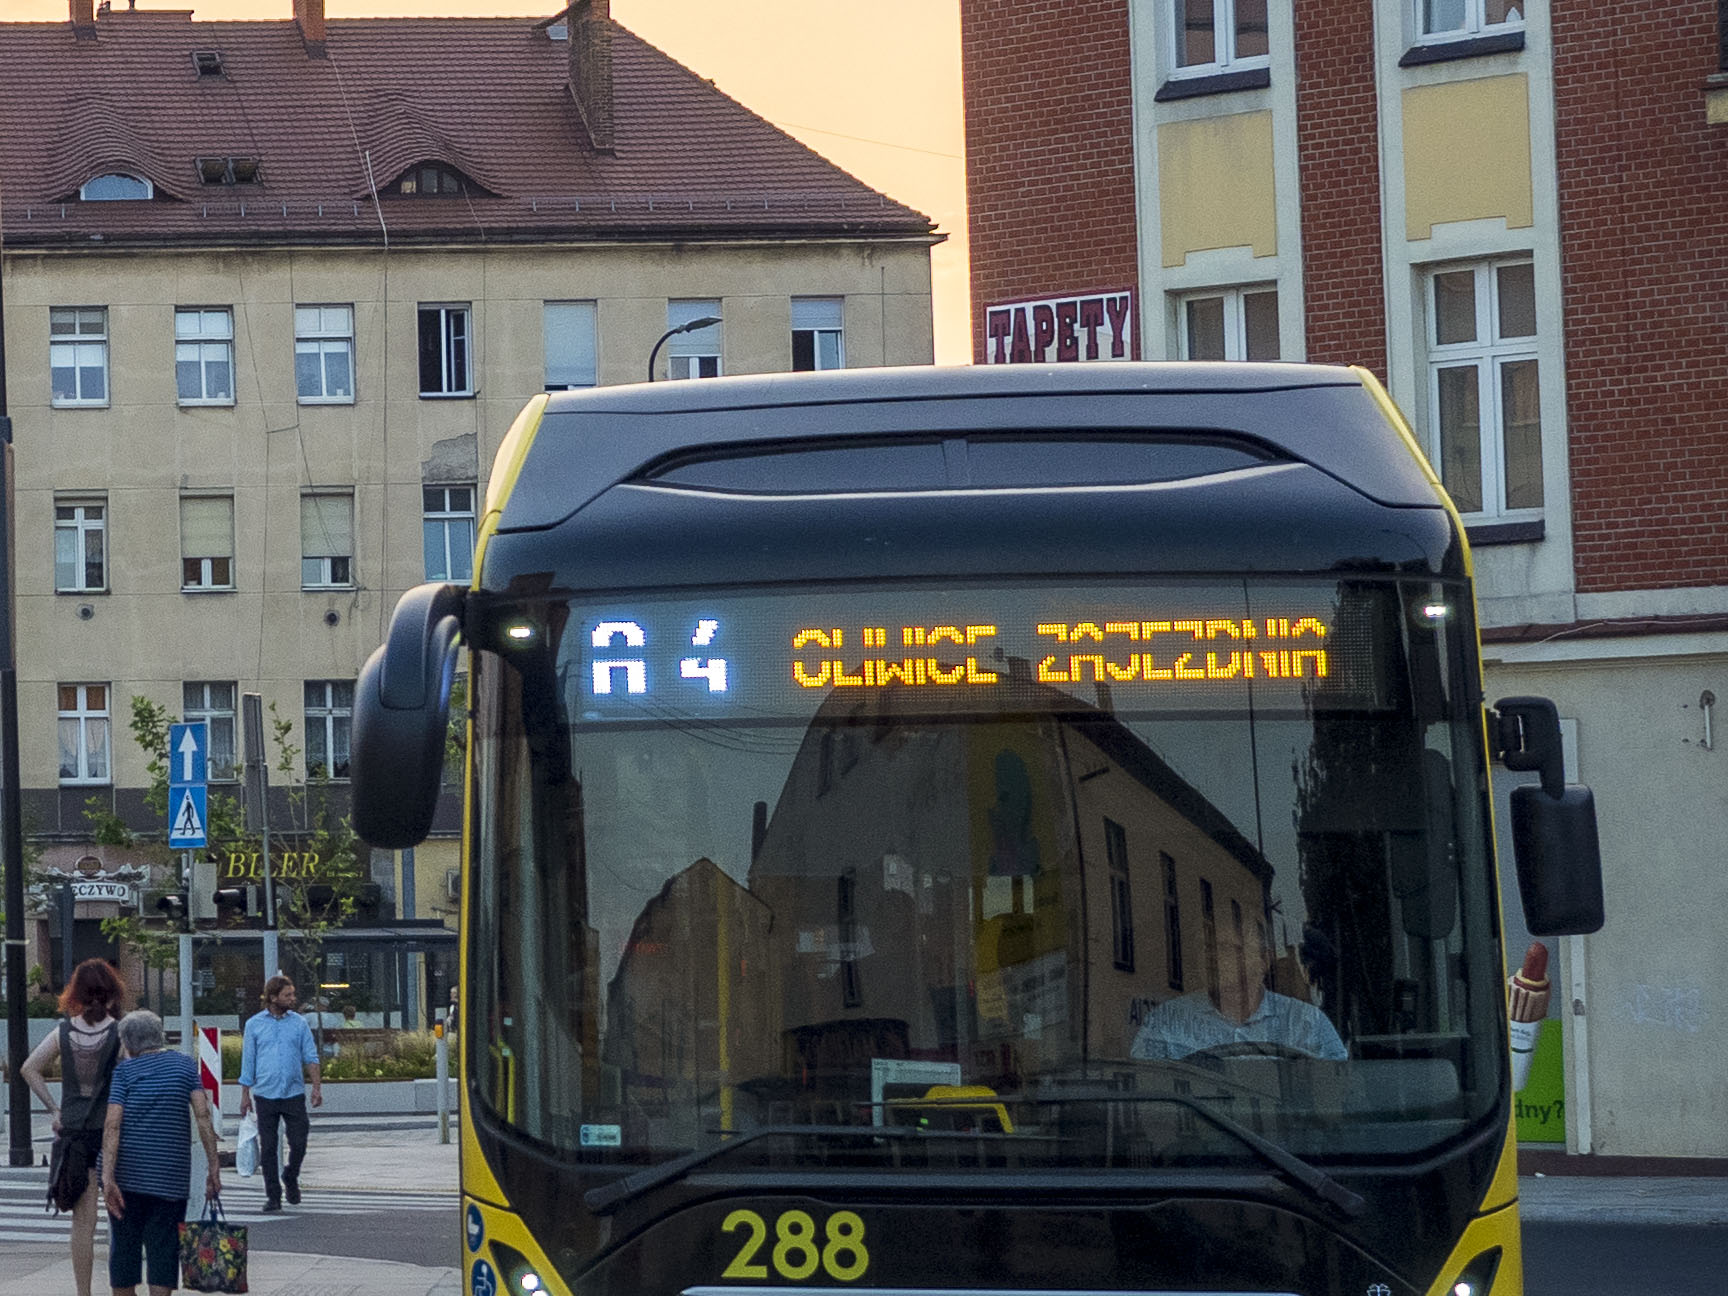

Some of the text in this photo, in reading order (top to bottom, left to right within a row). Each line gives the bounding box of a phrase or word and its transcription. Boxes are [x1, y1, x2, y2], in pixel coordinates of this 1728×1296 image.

[988, 295, 1130, 364] TAPETY
[589, 617, 729, 695] A 4
[791, 616, 1329, 688] GLIWICE ZAJEZDNIA
[71, 884, 126, 897] ECZYWO
[720, 1208, 870, 1282] 288
